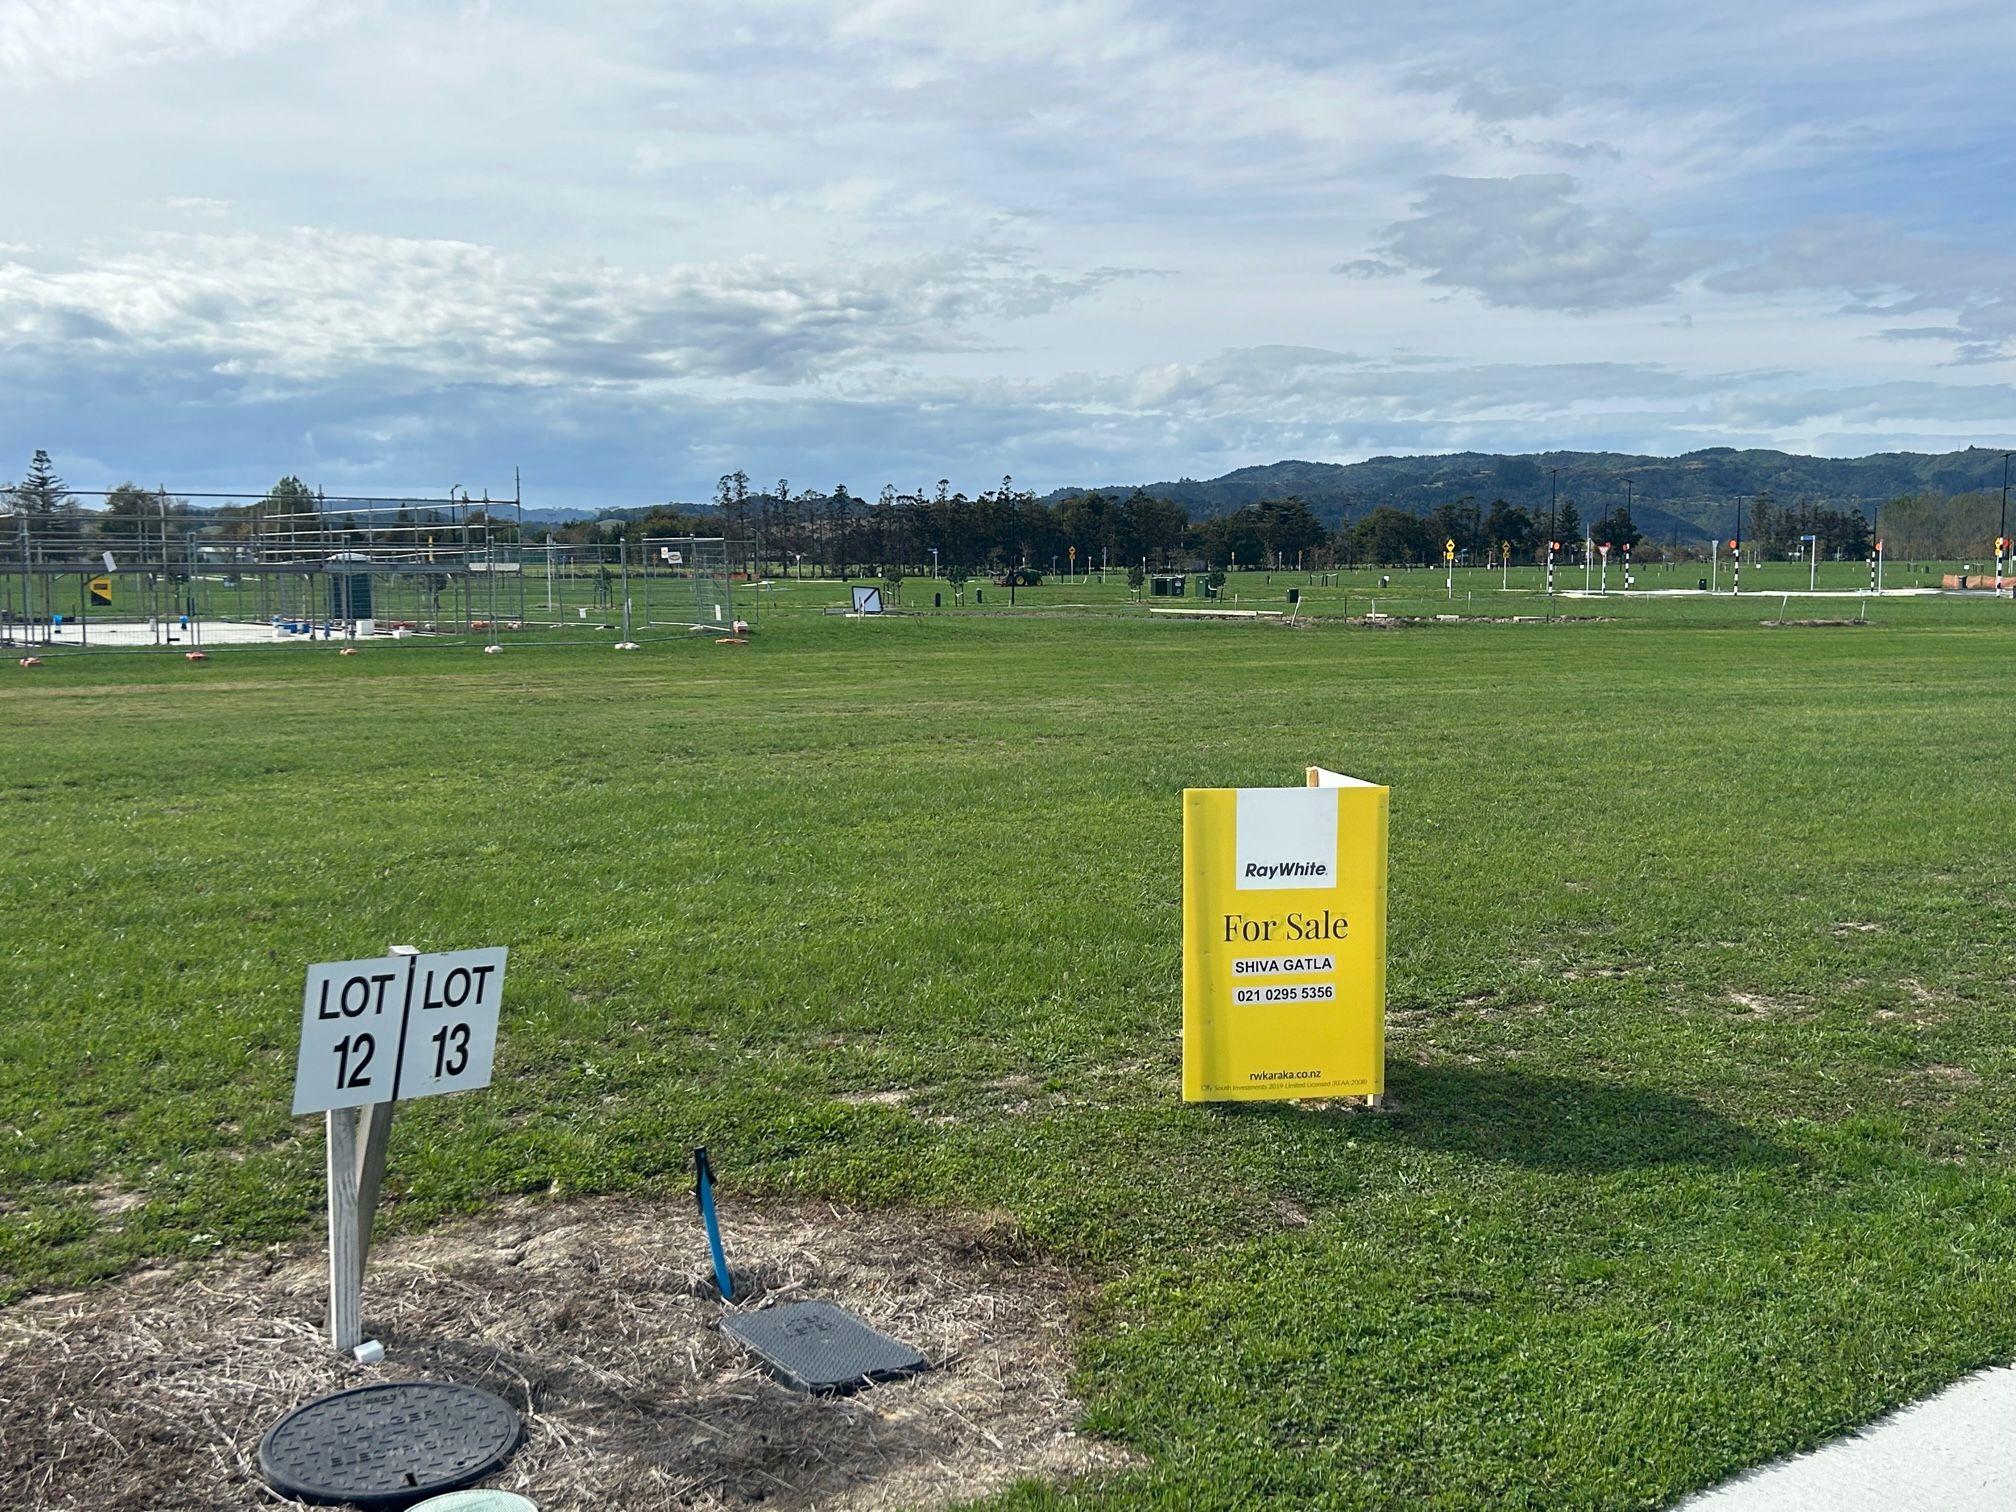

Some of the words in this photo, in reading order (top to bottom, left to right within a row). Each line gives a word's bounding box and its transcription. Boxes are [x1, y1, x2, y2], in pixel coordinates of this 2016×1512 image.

[1223, 914, 1278, 942] For
[1286, 909, 1348, 941] Sale
[1235, 959, 1279, 973] SHIVA
[1283, 957, 1332, 971] GATLA
[318, 973, 396, 1020] LOT
[422, 965, 495, 1010] LOT
[1237, 989, 1260, 1002] 021
[1265, 987, 1298, 1001] 0295
[1301, 986, 1333, 1000] 5356
[333, 1032, 376, 1090] 12
[432, 1022, 472, 1078] 13
[1232, 1083, 1267, 1091] Investments
[1269, 1082, 1284, 1090] 2019
[1285, 1081, 1305, 1089] Limited
[1306, 1080, 1331, 1088] Licensed
[1249, 1070, 1321, 1081] rwkaraka.co.nz
